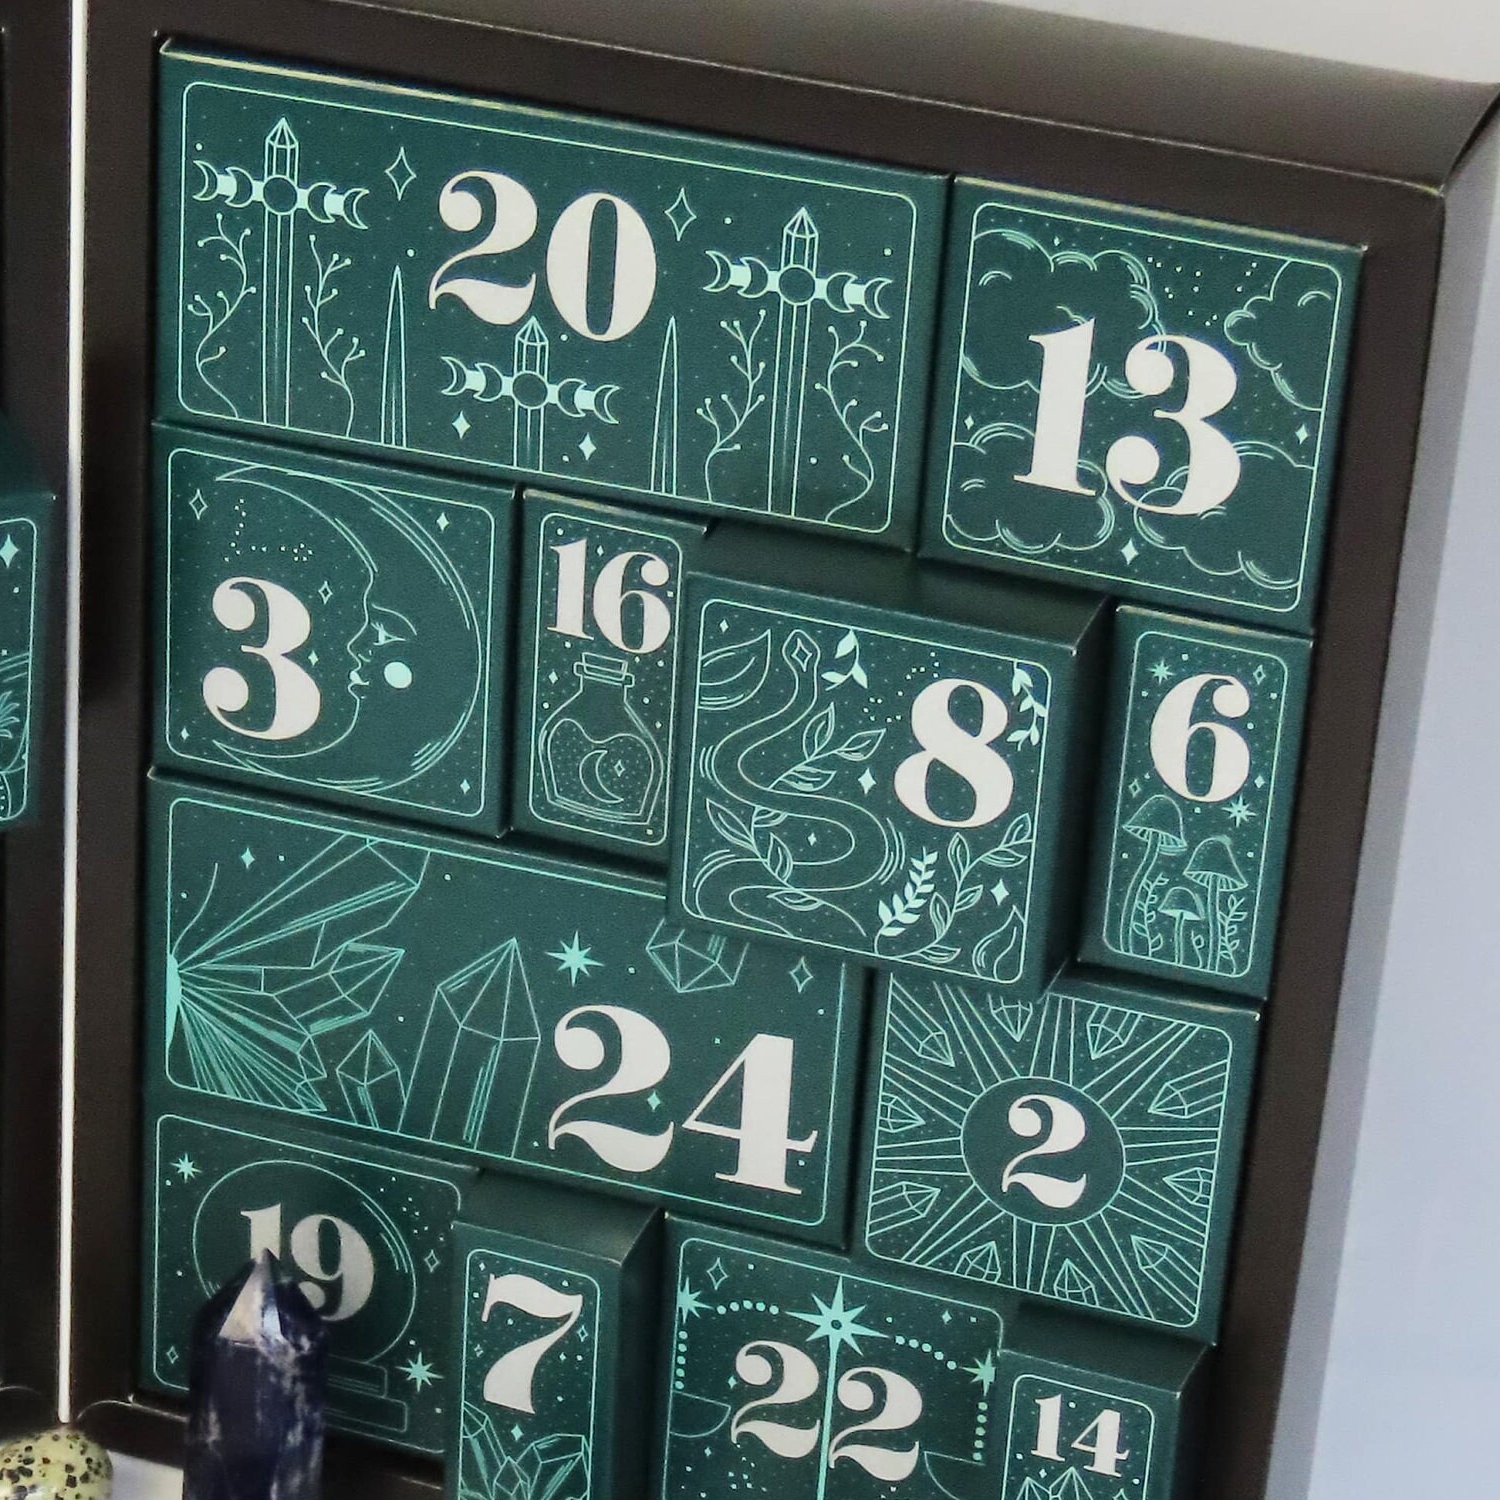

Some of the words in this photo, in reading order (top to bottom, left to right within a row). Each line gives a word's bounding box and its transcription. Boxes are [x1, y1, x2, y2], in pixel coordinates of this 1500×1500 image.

[428, 170, 657, 342] 20
[1013, 317, 1241, 515] 13
[203, 577, 320, 740] 3
[547, 538, 671, 654] 16
[894, 678, 1013, 827] 8
[1150, 673, 1250, 802] 6
[548, 1005, 818, 1194] 24
[1002, 1094, 1086, 1208] 2
[482, 1273, 583, 1414] 7
[731, 1341, 922, 1481] 22
[1031, 1394, 1130, 1477] 14
